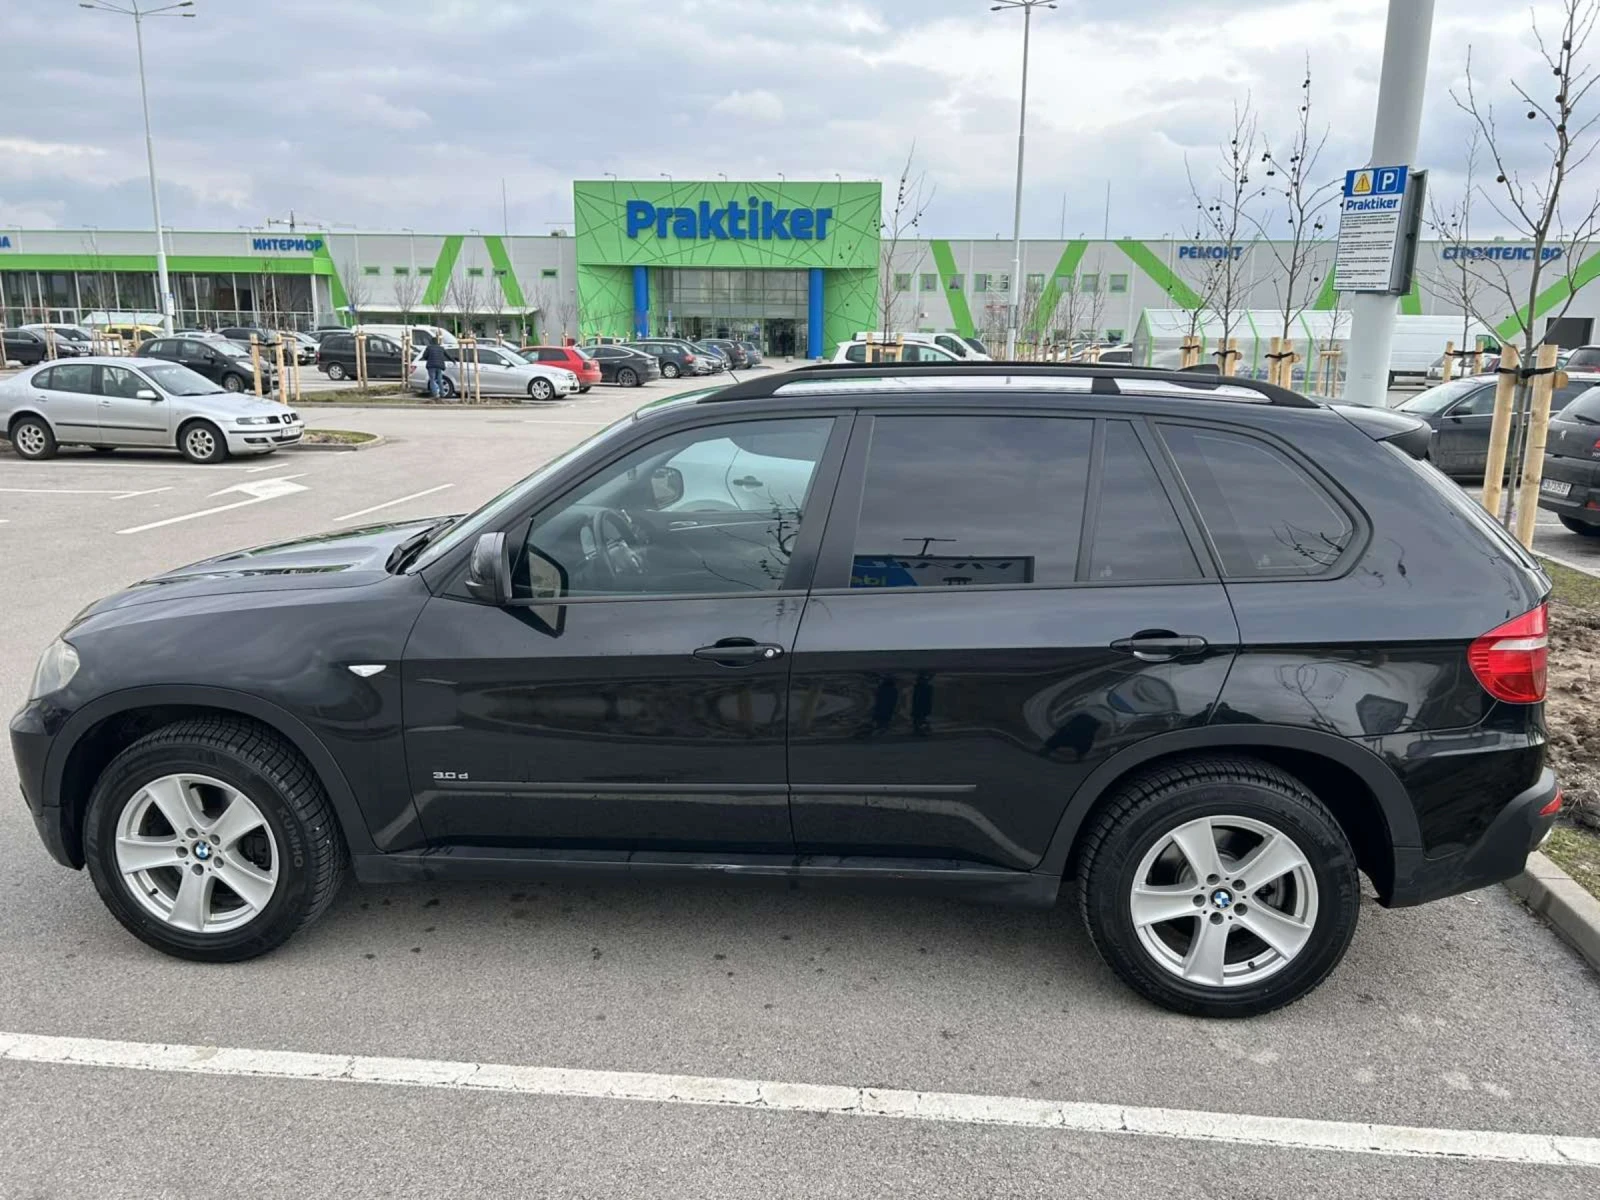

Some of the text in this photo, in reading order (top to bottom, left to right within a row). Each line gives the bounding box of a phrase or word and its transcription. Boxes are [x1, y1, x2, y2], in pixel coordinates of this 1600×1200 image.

[1382, 171, 1395, 190] P
[1346, 197, 1399, 211] Praktiker
[626, 196, 833, 240] Praktiker
[253, 238, 323, 251] ИНТЕРИОР
[1179, 246, 1242, 259] РЕМОНТ
